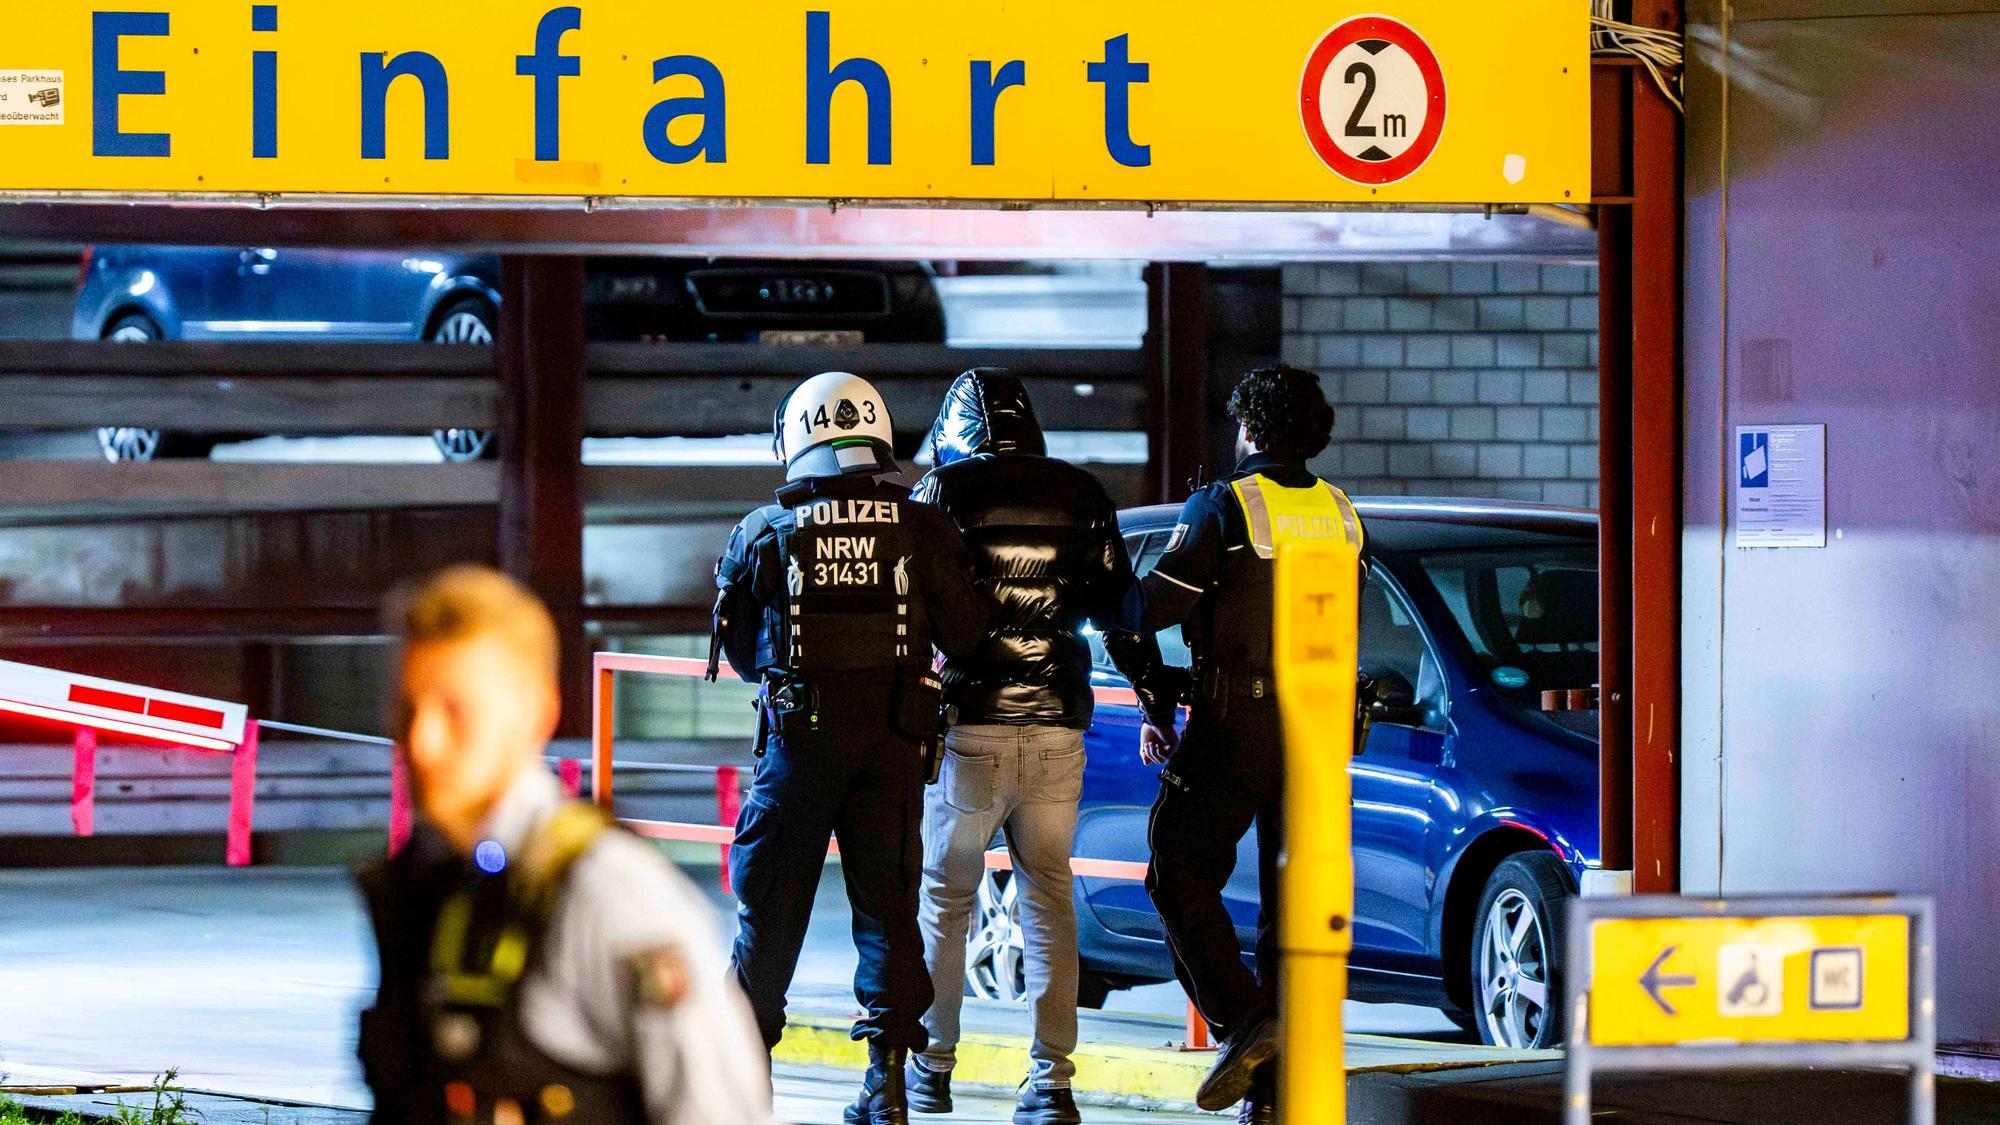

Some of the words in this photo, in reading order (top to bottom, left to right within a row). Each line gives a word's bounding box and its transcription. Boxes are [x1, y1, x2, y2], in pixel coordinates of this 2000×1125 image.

[21, 74, 62, 83] Parkhaus
[93, 6, 1151, 167] Einfahrt
[1344, 62, 1377, 137] 2
[1383, 114, 1406, 138] m
[0, 112, 59, 121] eoüberwacht
[799, 404, 831, 435] 14
[862, 400, 876, 425] 3
[796, 500, 899, 528] POLIZEI
[816, 536, 876, 559] NRW
[814, 561, 879, 586] 31431
